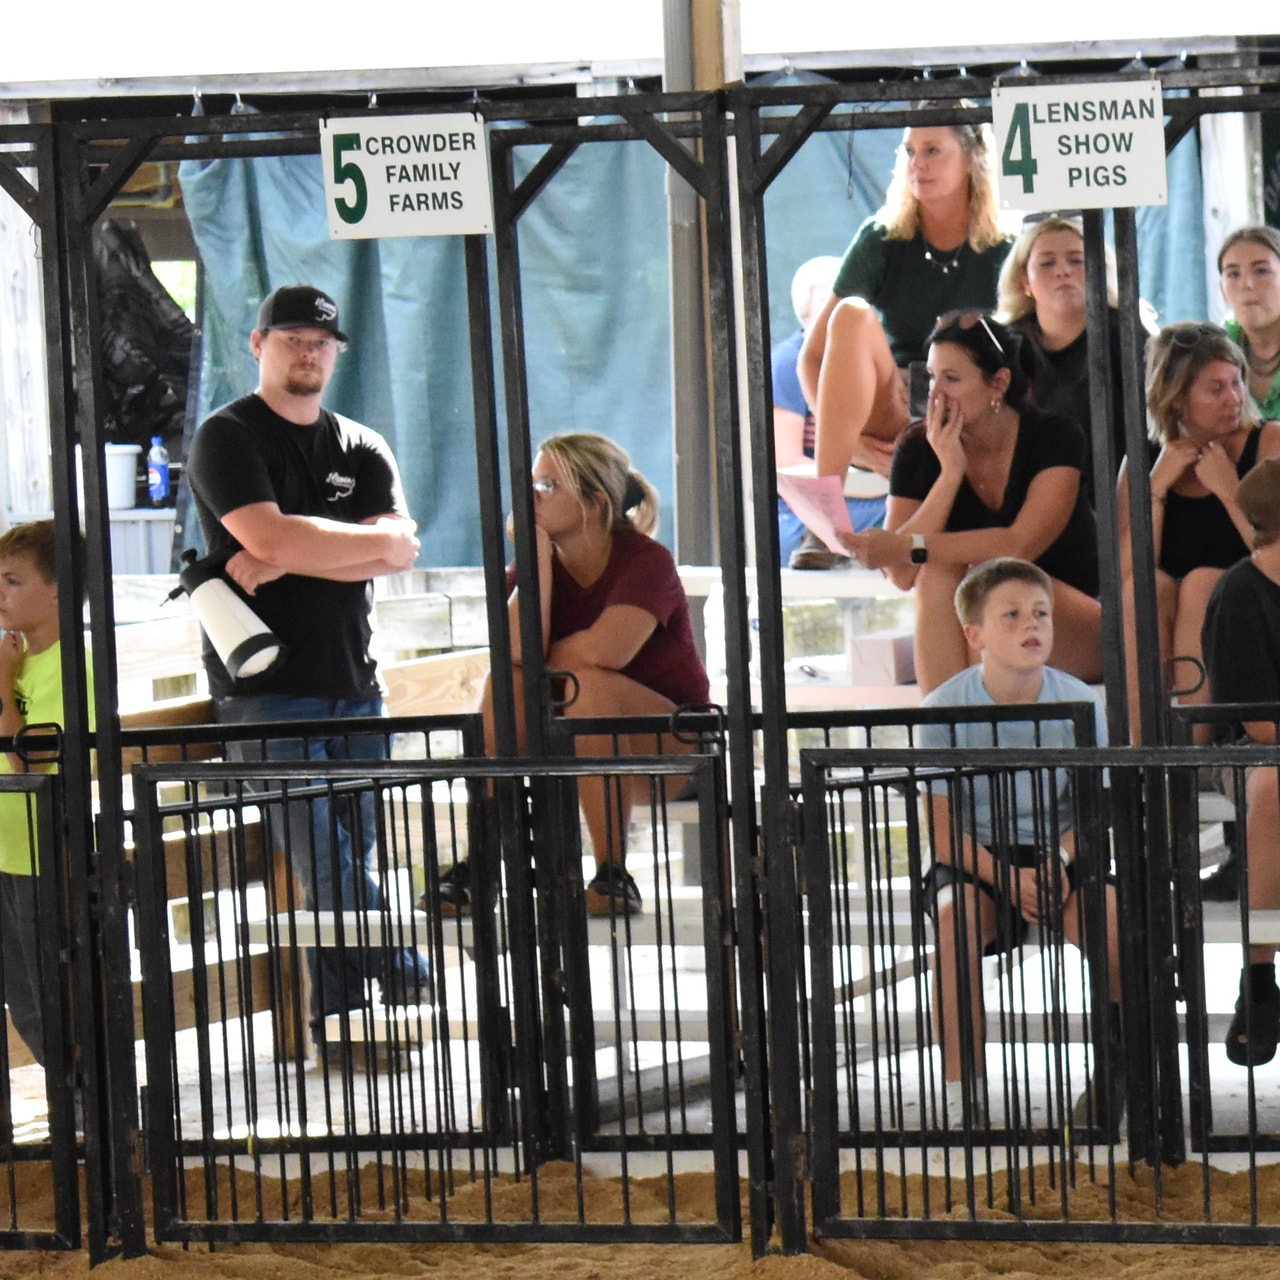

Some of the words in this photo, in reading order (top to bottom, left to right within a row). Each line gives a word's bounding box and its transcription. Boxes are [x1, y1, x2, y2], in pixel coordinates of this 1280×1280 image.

[1032, 98, 1155, 124] LENSMAN
[365, 132, 476, 156] CROWDER
[1002, 102, 1038, 194] 4
[1057, 132, 1133, 156] SHOW
[332, 132, 368, 225] 5
[385, 162, 461, 184] FAMILY
[1068, 165, 1127, 188] PIGS
[389, 191, 463, 213] FARMS
